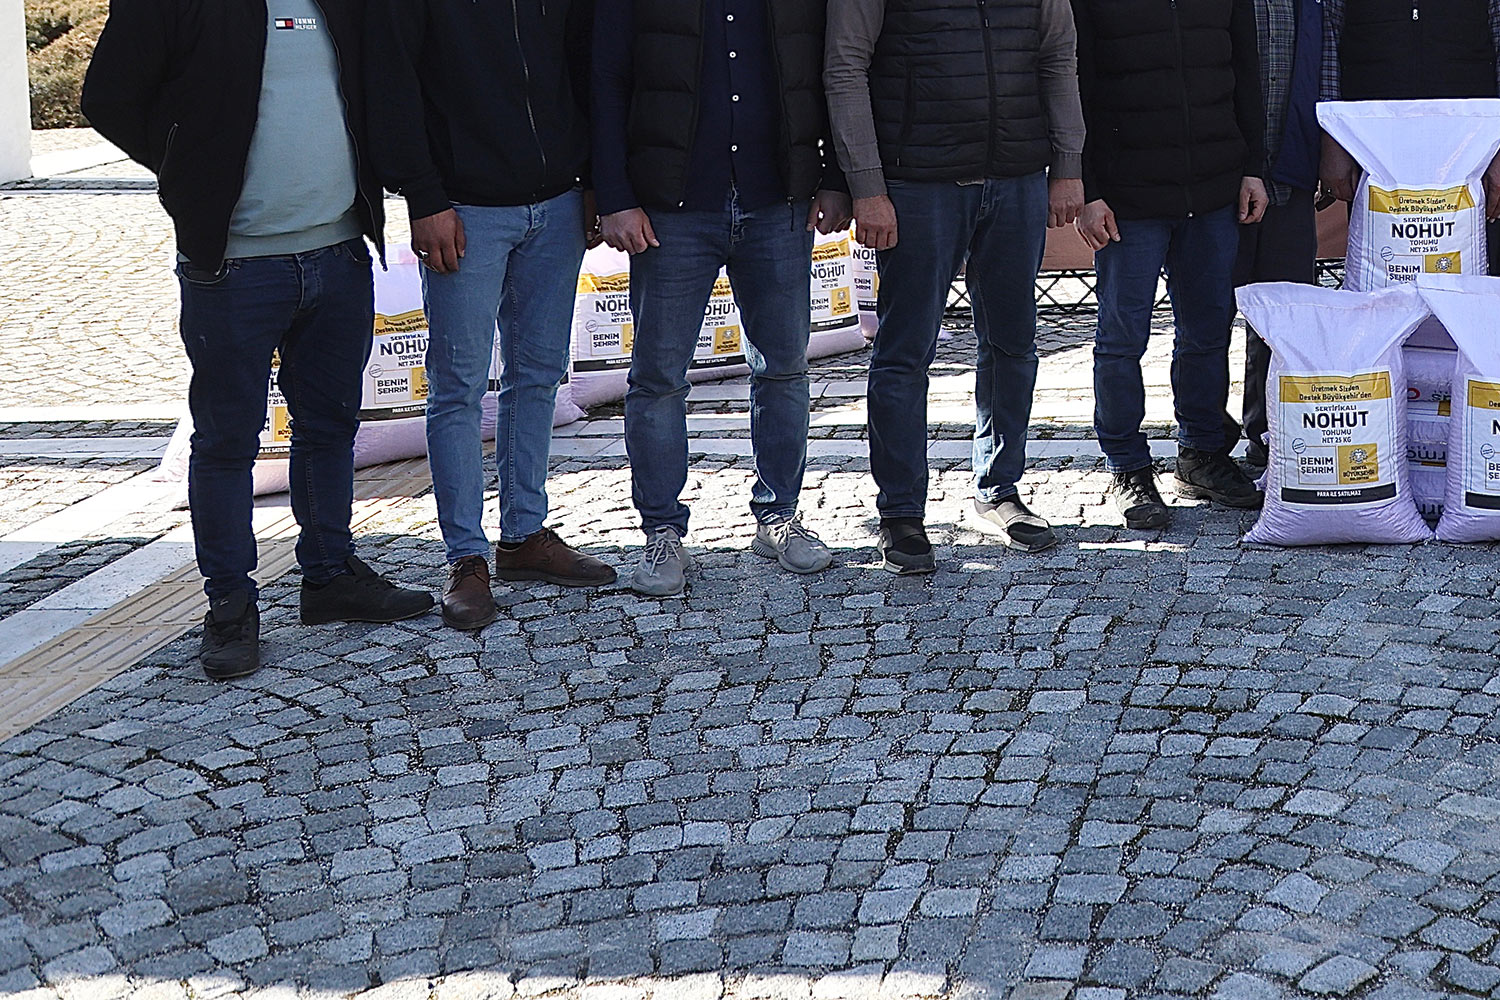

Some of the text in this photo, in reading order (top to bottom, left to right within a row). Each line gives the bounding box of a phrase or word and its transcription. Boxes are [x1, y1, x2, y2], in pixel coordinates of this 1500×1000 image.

[1391, 222, 1455, 239] NOHUT
[852, 249, 876, 260] NOH
[1388, 264, 1420, 273] BENİM
[595, 300, 629, 313] NOH
[593, 333, 620, 341] BENİM
[380, 338, 429, 356] NOHU
[377, 378, 408, 387] BENİM
[1311, 384, 1338, 392] Üretmek
[1314, 404, 1357, 412] SERTİFİKALI
[1303, 411, 1369, 428] NOHUT
[1300, 456, 1334, 466] BENİM
[1300, 465, 1334, 475] ŞEHRİM
